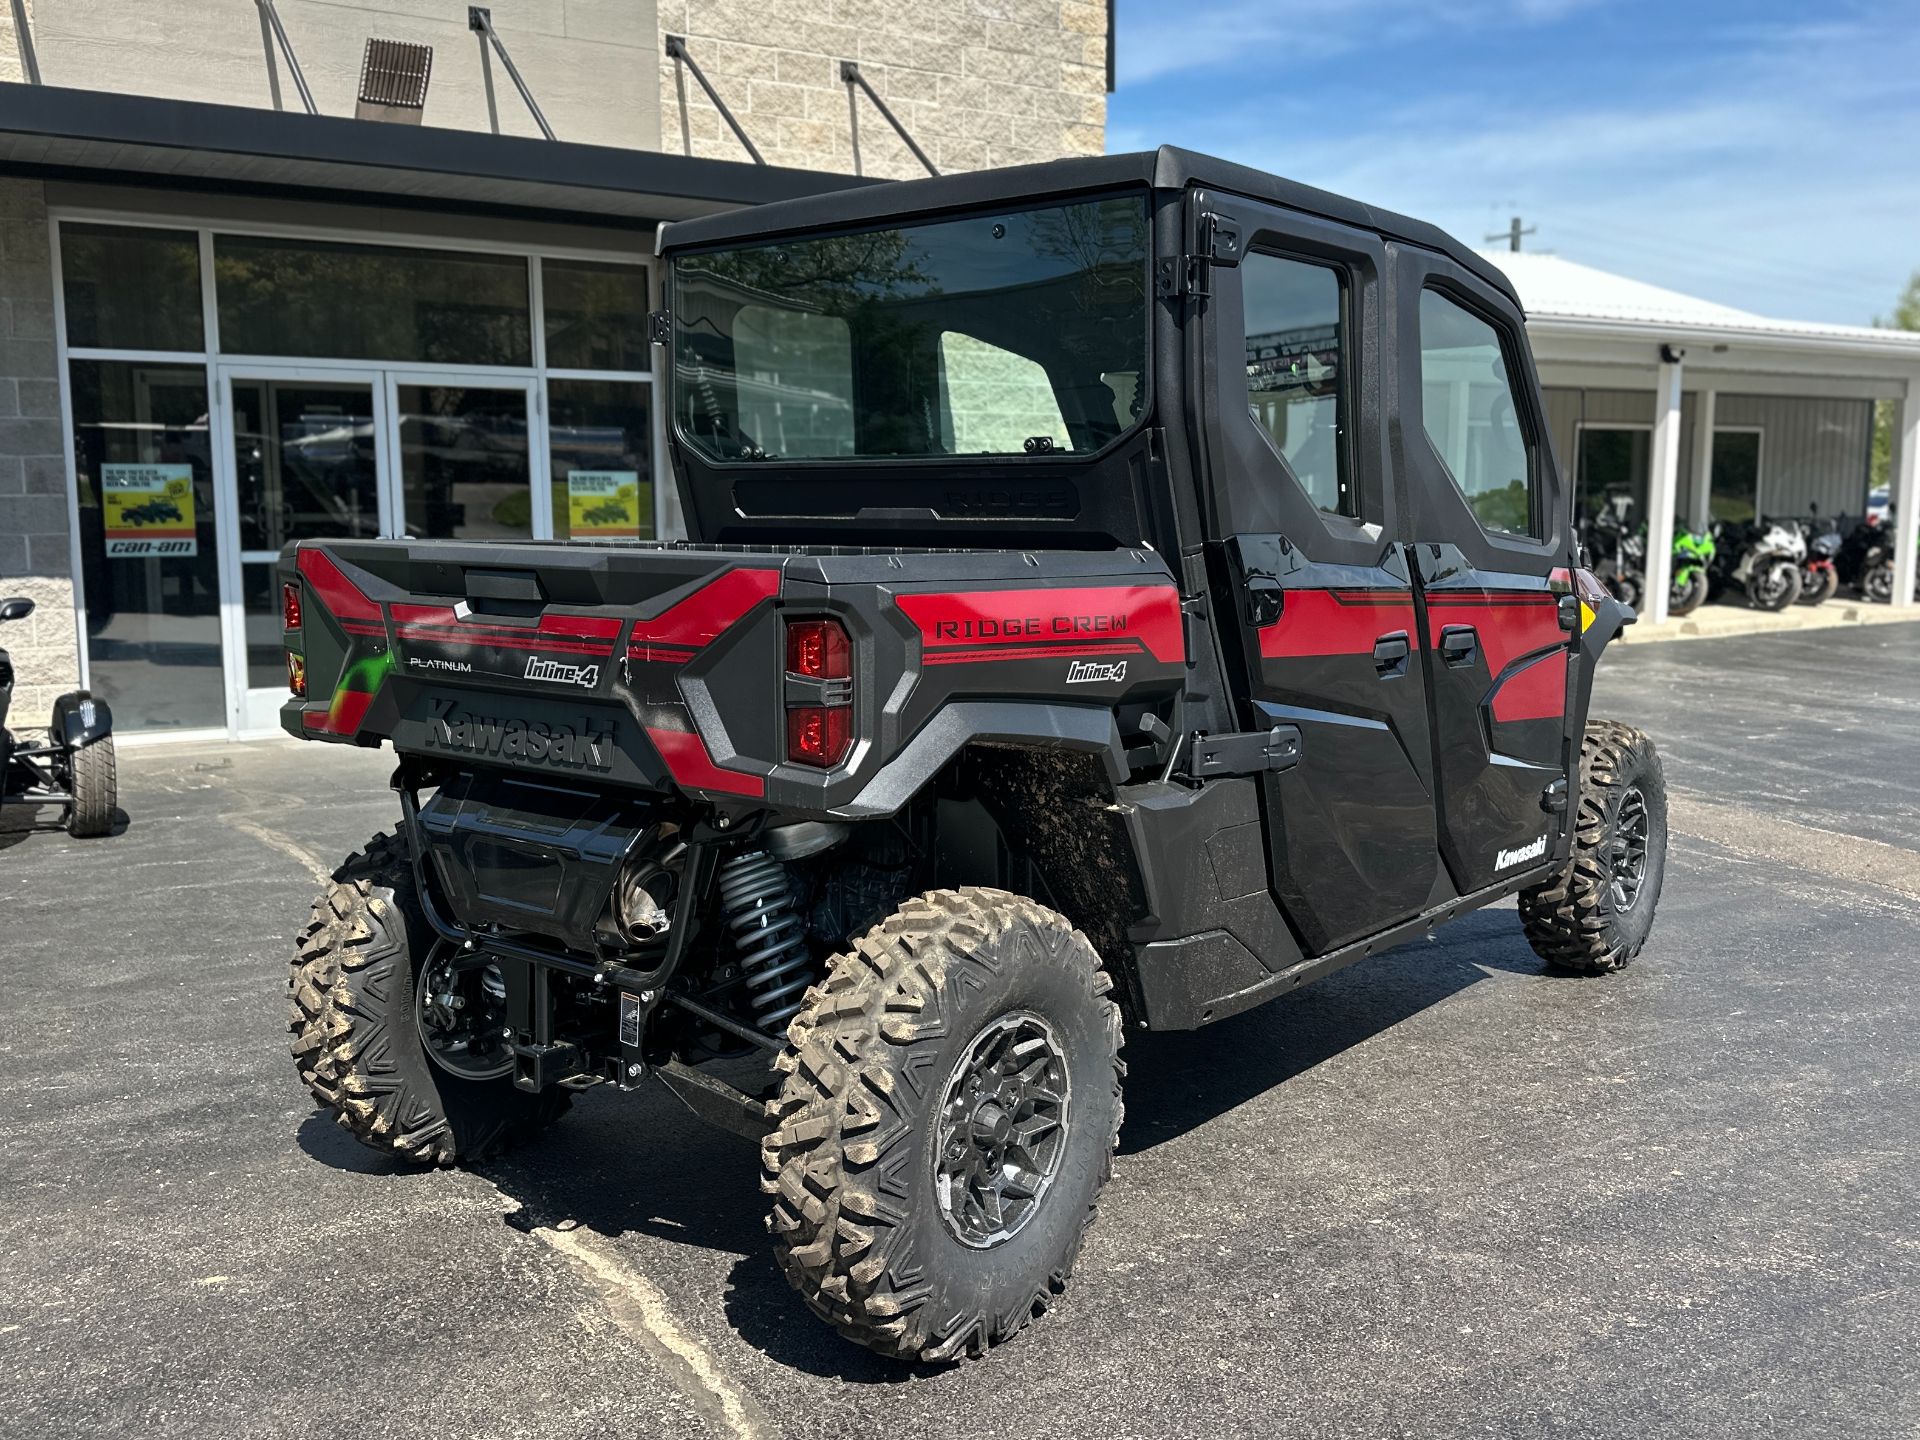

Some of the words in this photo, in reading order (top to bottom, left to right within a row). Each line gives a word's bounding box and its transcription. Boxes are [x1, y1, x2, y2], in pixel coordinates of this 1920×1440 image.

[111, 541, 192, 553] can-am
[935, 618, 1041, 639] RIDGE
[1052, 614, 1128, 634] CREW
[410, 657, 472, 673] PLATINUM
[523, 655, 599, 688] Inline-4
[1065, 660, 1128, 684] Inline-4
[425, 698, 619, 773] Kawasaki
[1494, 834, 1547, 871] Kawasaki
